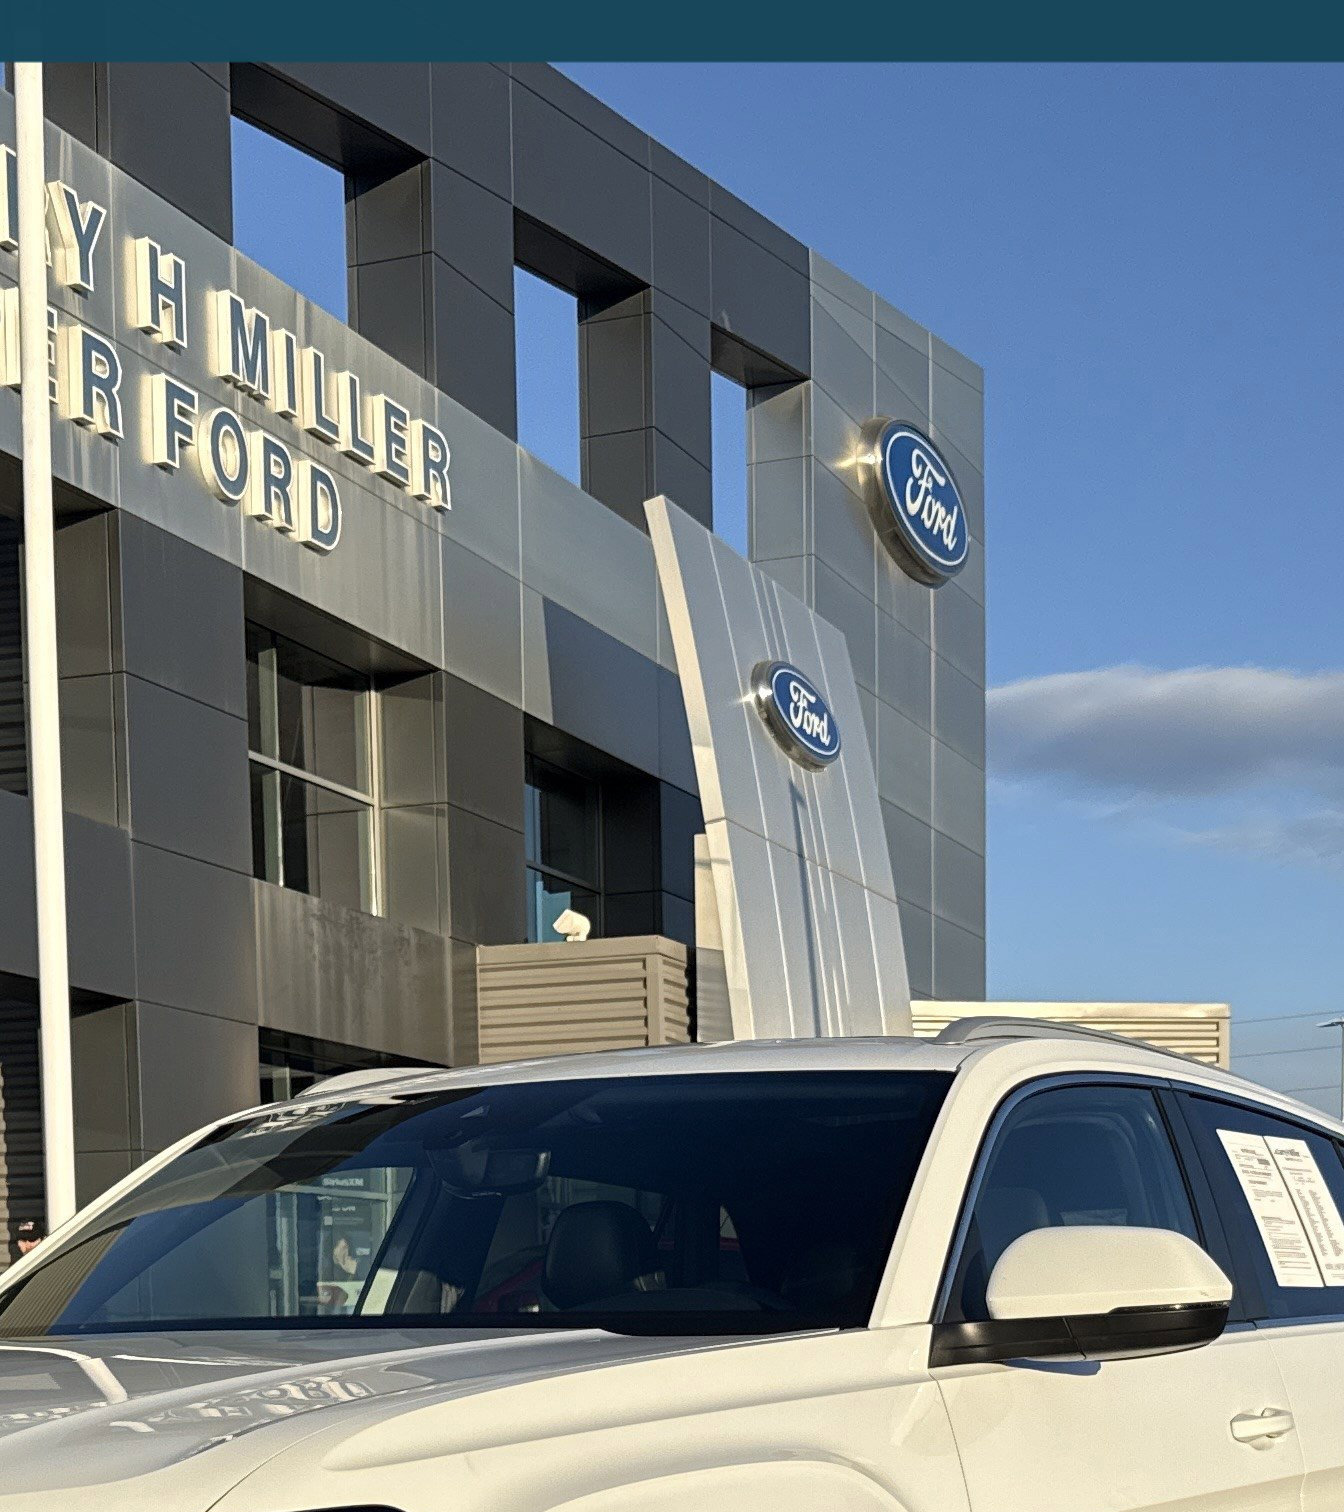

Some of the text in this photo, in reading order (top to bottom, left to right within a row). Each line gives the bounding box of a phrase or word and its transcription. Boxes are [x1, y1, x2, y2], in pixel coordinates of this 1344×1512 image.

[135, 236, 189, 349] H
[217, 289, 451, 511] MILLER
[151, 372, 343, 553] FORD
[905, 448, 959, 551] Ford
[789, 680, 831, 746] Ford
